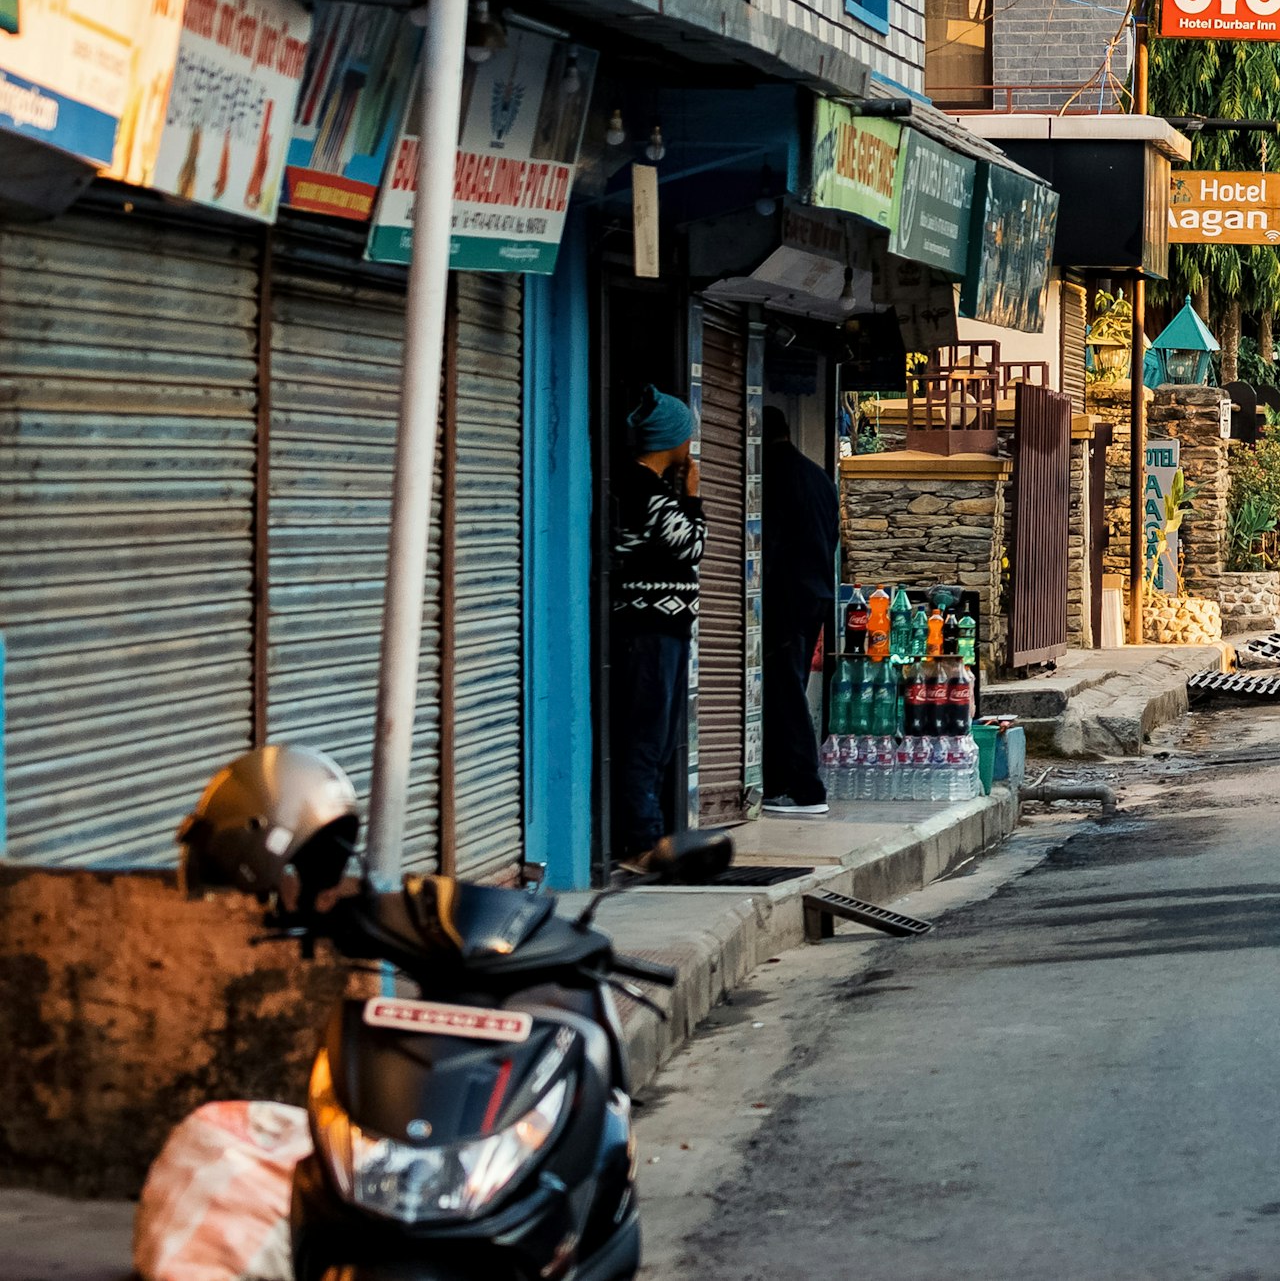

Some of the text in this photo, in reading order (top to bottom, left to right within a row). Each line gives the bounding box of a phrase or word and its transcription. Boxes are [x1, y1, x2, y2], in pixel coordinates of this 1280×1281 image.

[1179, 18, 1277, 31] Hotel Durbar Inn
[1200, 178, 1266, 203] Hotel
[1145, 448, 1177, 468] OTEL
